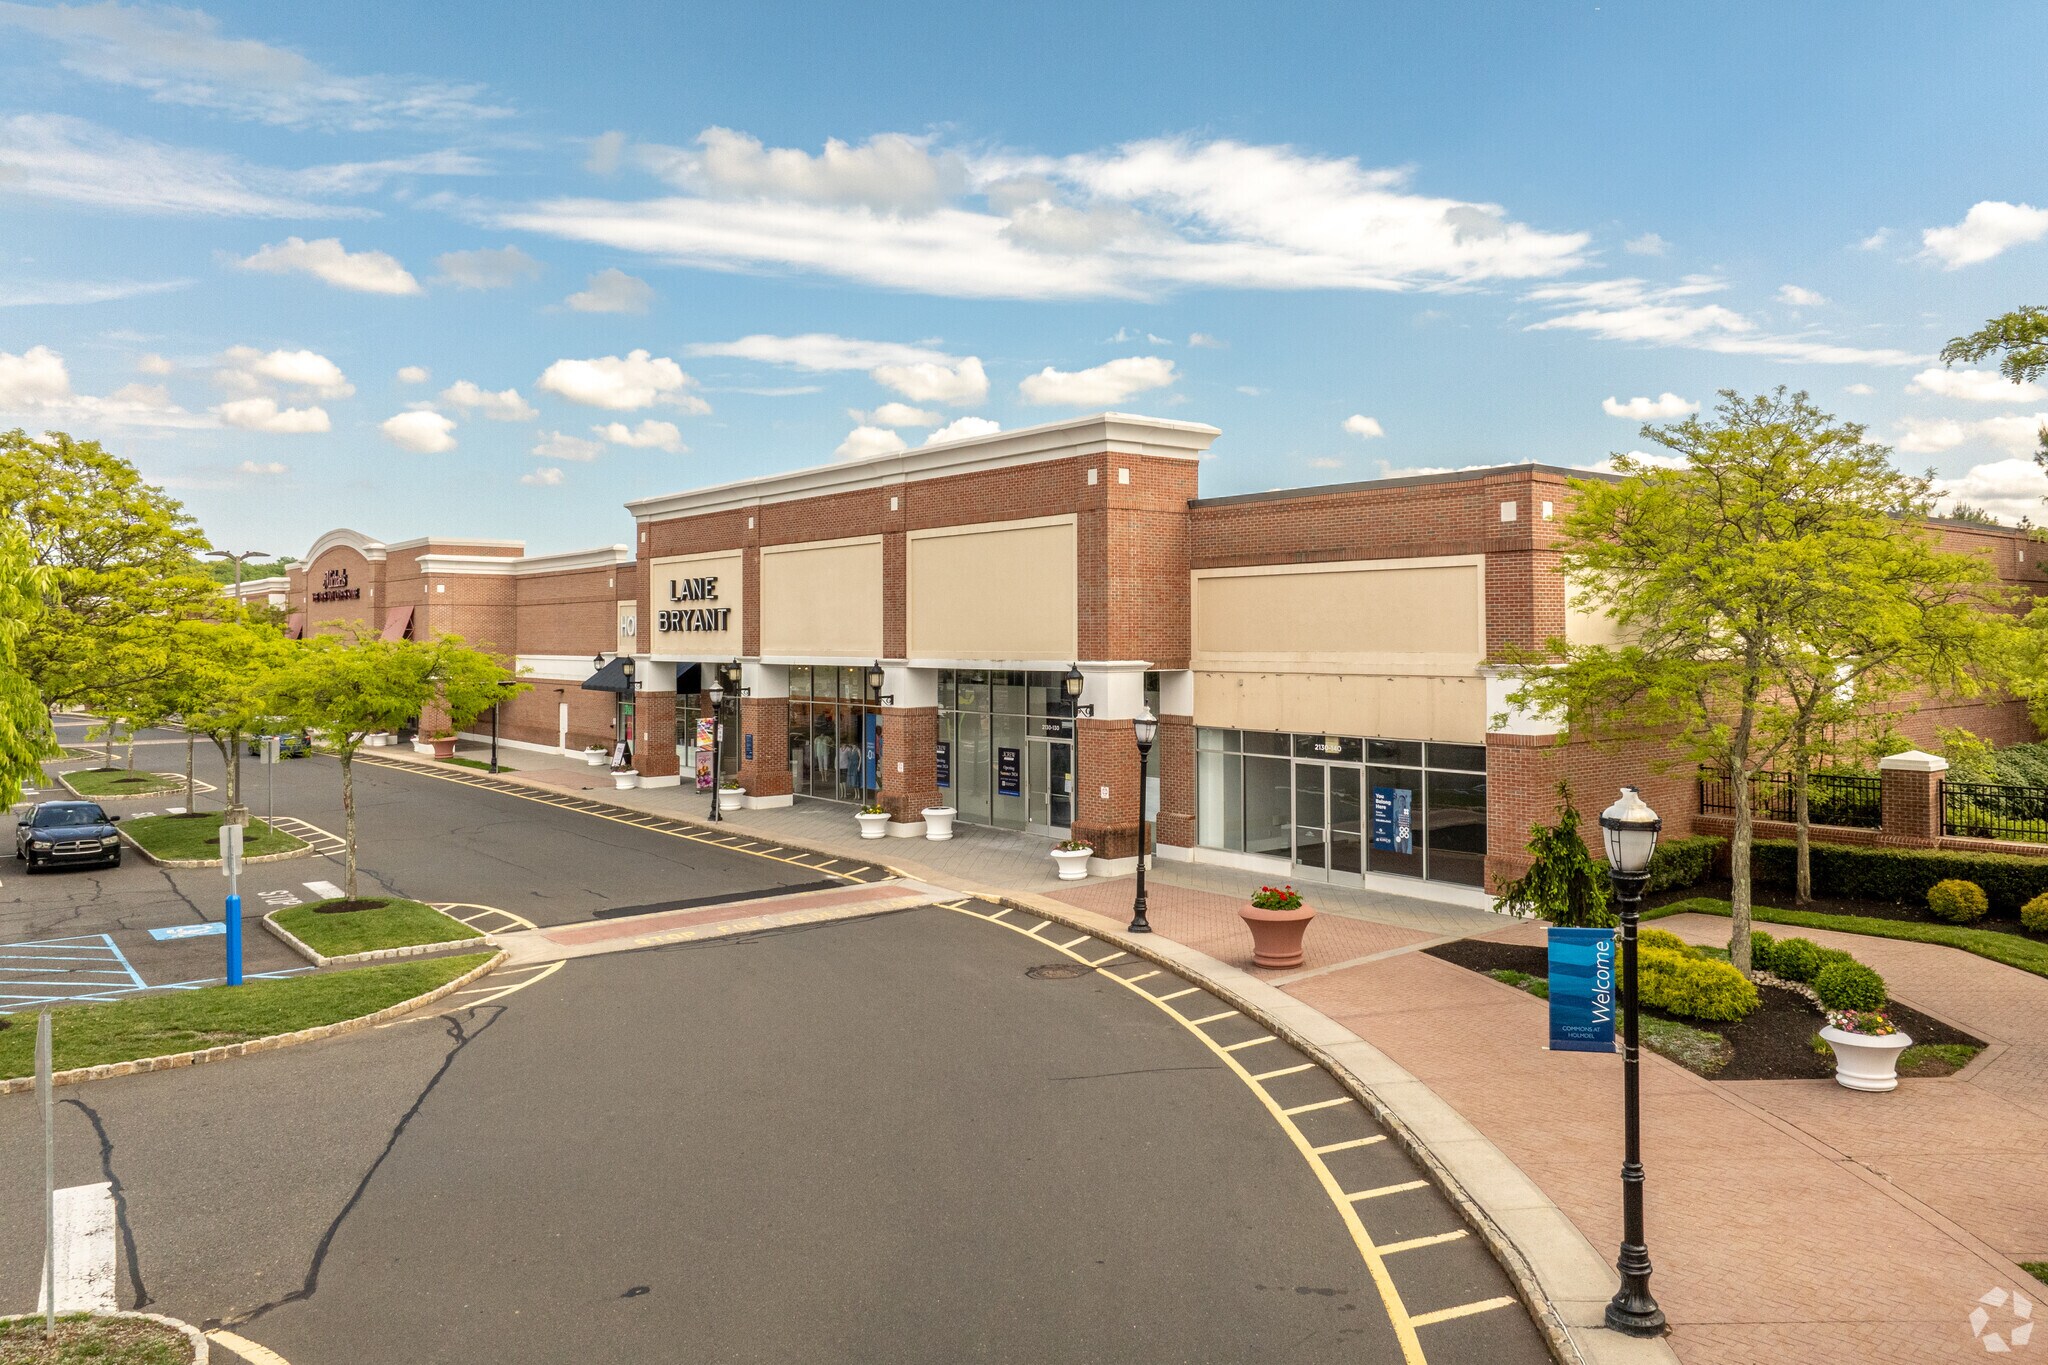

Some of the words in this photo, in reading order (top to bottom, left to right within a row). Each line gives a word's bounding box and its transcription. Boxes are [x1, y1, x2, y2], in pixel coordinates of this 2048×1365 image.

[670, 577, 718, 602] LANE
[659, 608, 731, 632] BRYANT
[1591, 941, 1611, 1023] Welcome
[1562, 1025, 1593, 1033] COMMONS
